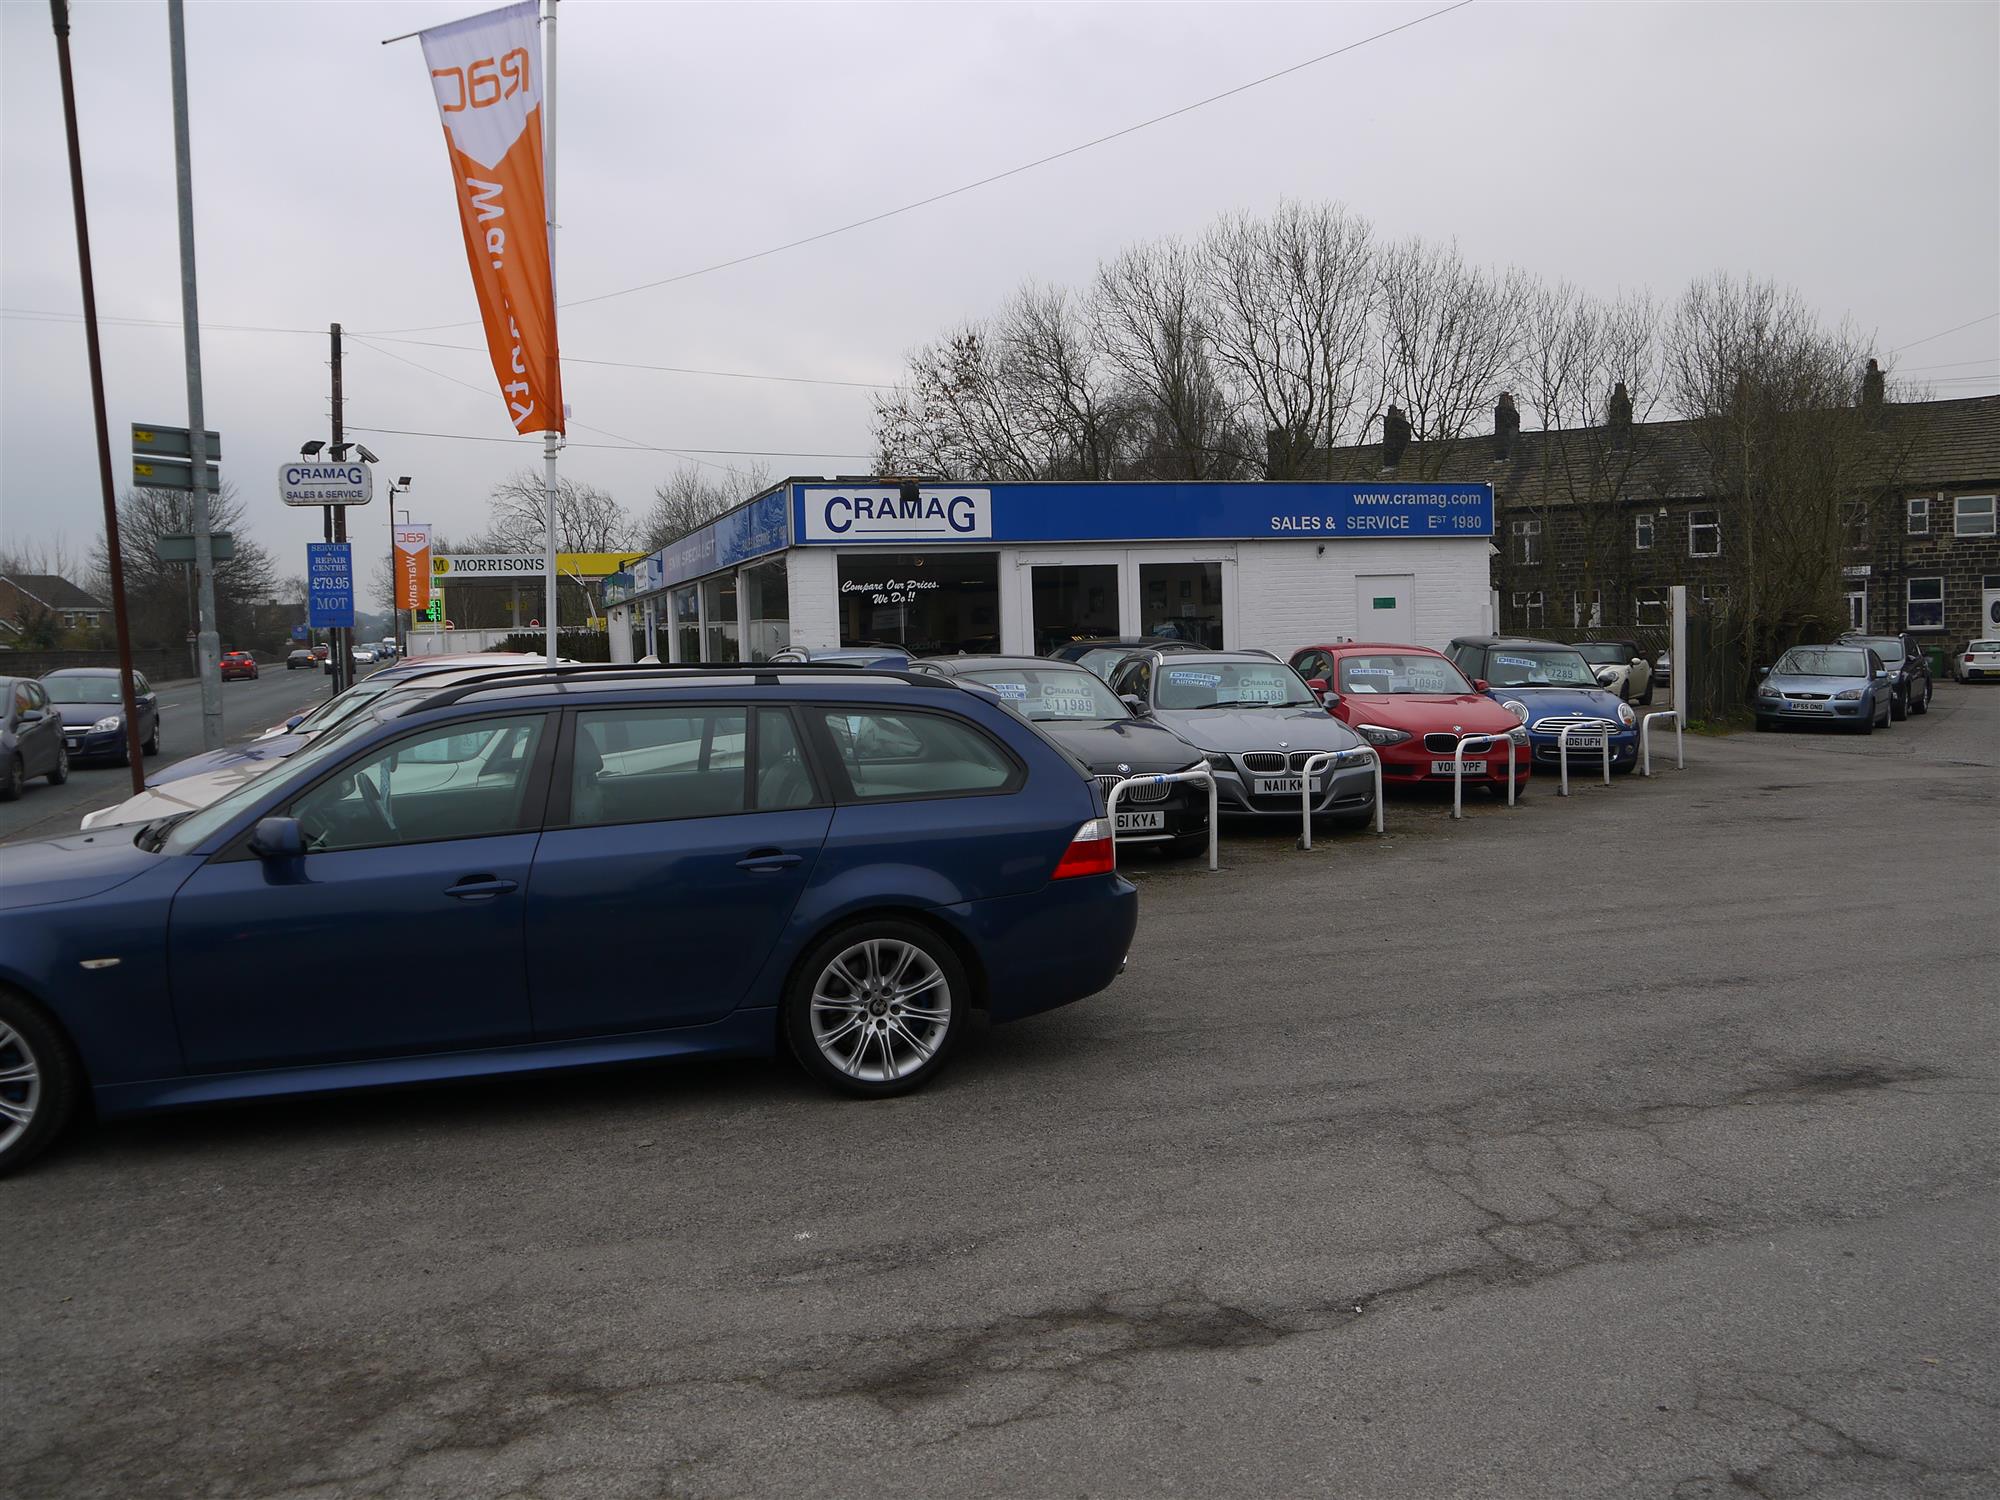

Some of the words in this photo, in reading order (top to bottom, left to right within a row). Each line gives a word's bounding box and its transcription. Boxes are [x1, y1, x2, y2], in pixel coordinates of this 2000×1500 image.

[286, 467, 362, 485] CRAMAG
[286, 491, 315, 499] SALES
[317, 490, 323, 499] &
[325, 490, 364, 498] SERVICE
[1353, 493, 1481, 508] www.cramag.com
[825, 496, 976, 533] CRAMAG
[1271, 517, 1321, 530] SALES
[1325, 517, 1336, 530] &
[1346, 516, 1410, 529] SERVICE
[1452, 516, 1482, 529] 1980
[311, 544, 349, 552] SERVICE
[433, 560, 445, 571] M
[454, 559, 545, 571] MORRISONS
[312, 577, 350, 590] £79.95
[841, 580, 883, 593] Compare
[886, 579, 905, 590] Our
[316, 597, 349, 610] MOT
[872, 593, 888, 604] We
[1498, 656, 1536, 667] DIESEL
[1171, 672, 1219, 680] DIESEL
[1174, 680, 1213, 688] AUTOMATIC
[1241, 679, 1285, 688] CRAMAG
[1044, 686, 1091, 697] CRAMAG
[1584, 738, 1600, 746] UFH
[1463, 762, 1481, 771] YPF
[1264, 780, 1286, 791] NA11
[1132, 814, 1156, 827] KYA
